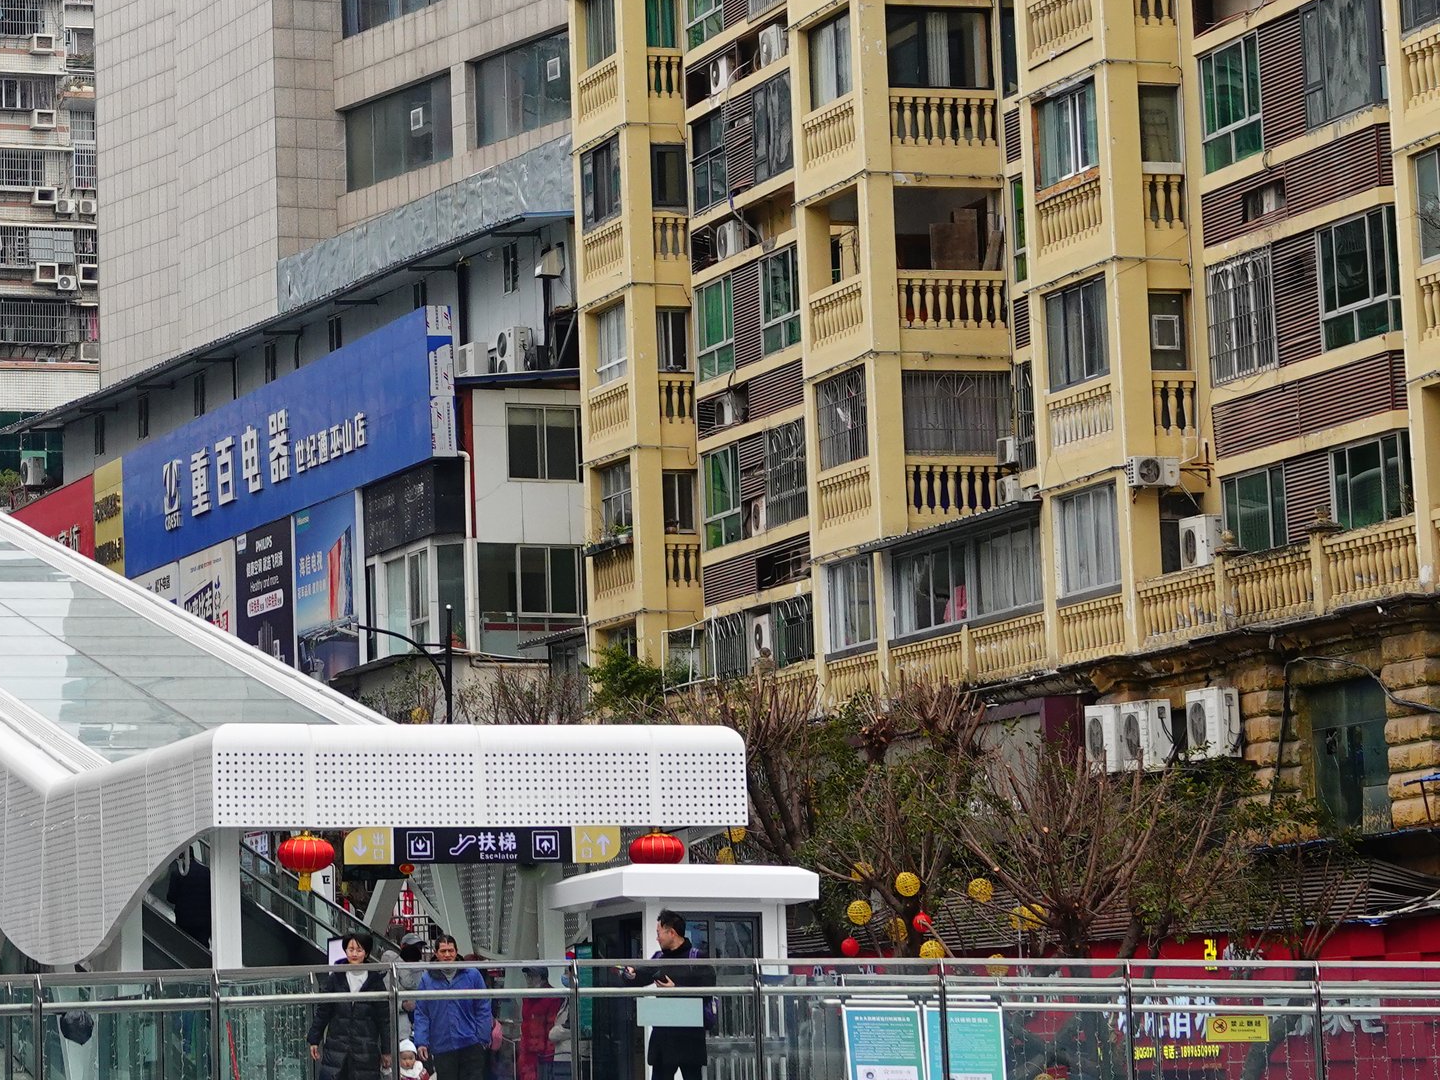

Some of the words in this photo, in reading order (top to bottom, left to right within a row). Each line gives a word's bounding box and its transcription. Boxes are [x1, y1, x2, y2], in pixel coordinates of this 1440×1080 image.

[190, 408, 291, 517] 重百电器
[294, 411, 368, 473] 世纪通巫山店
[255, 535, 272, 553] PHILIPS
[299, 550, 323, 577] 海信电视
[372, 832, 385, 860] 出口
[478, 831, 517, 852] 扶梯
[580, 831, 593, 859] 入口
[479, 852, 518, 860] Escalator
